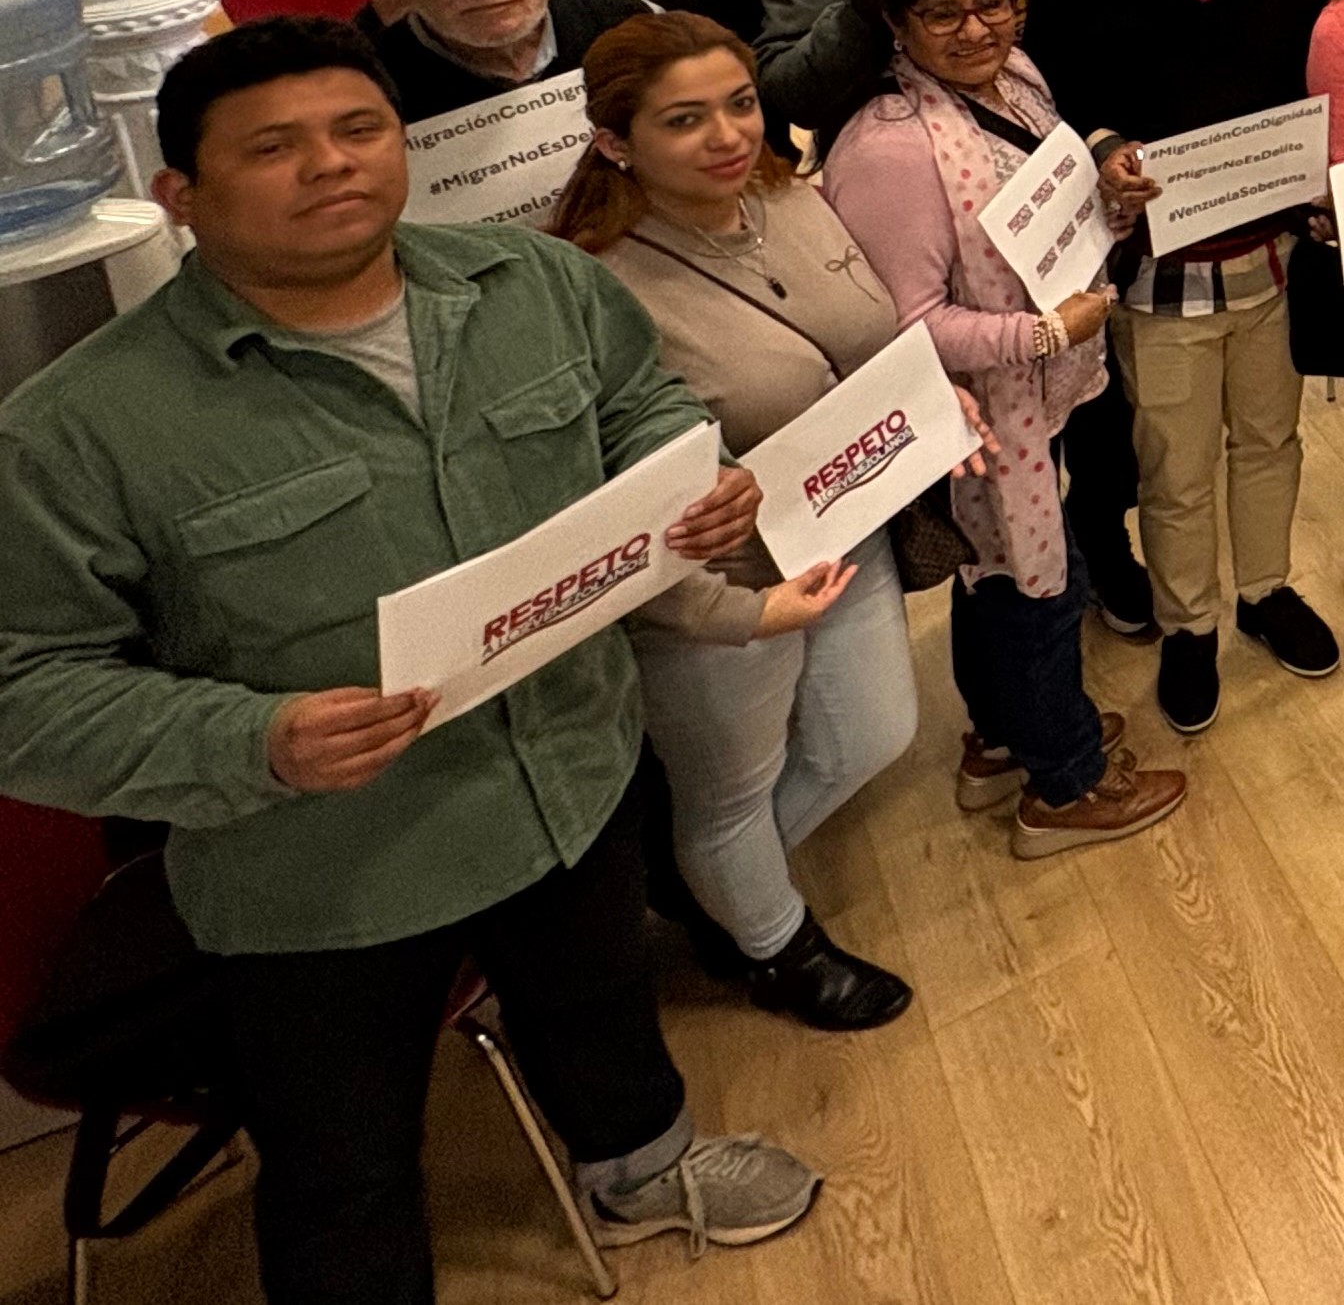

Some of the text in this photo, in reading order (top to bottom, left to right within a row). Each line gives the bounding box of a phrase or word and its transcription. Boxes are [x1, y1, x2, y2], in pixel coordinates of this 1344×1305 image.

[1150, 104, 1322, 160] #MigraciónConDignidad
[1167, 142, 1303, 183] #MigrarNoEsDelito
[1169, 172, 1306, 222] #VenzuelaSoberana
[803, 409, 906, 502] RESPETO
[483, 532, 651, 646] RESPETO
